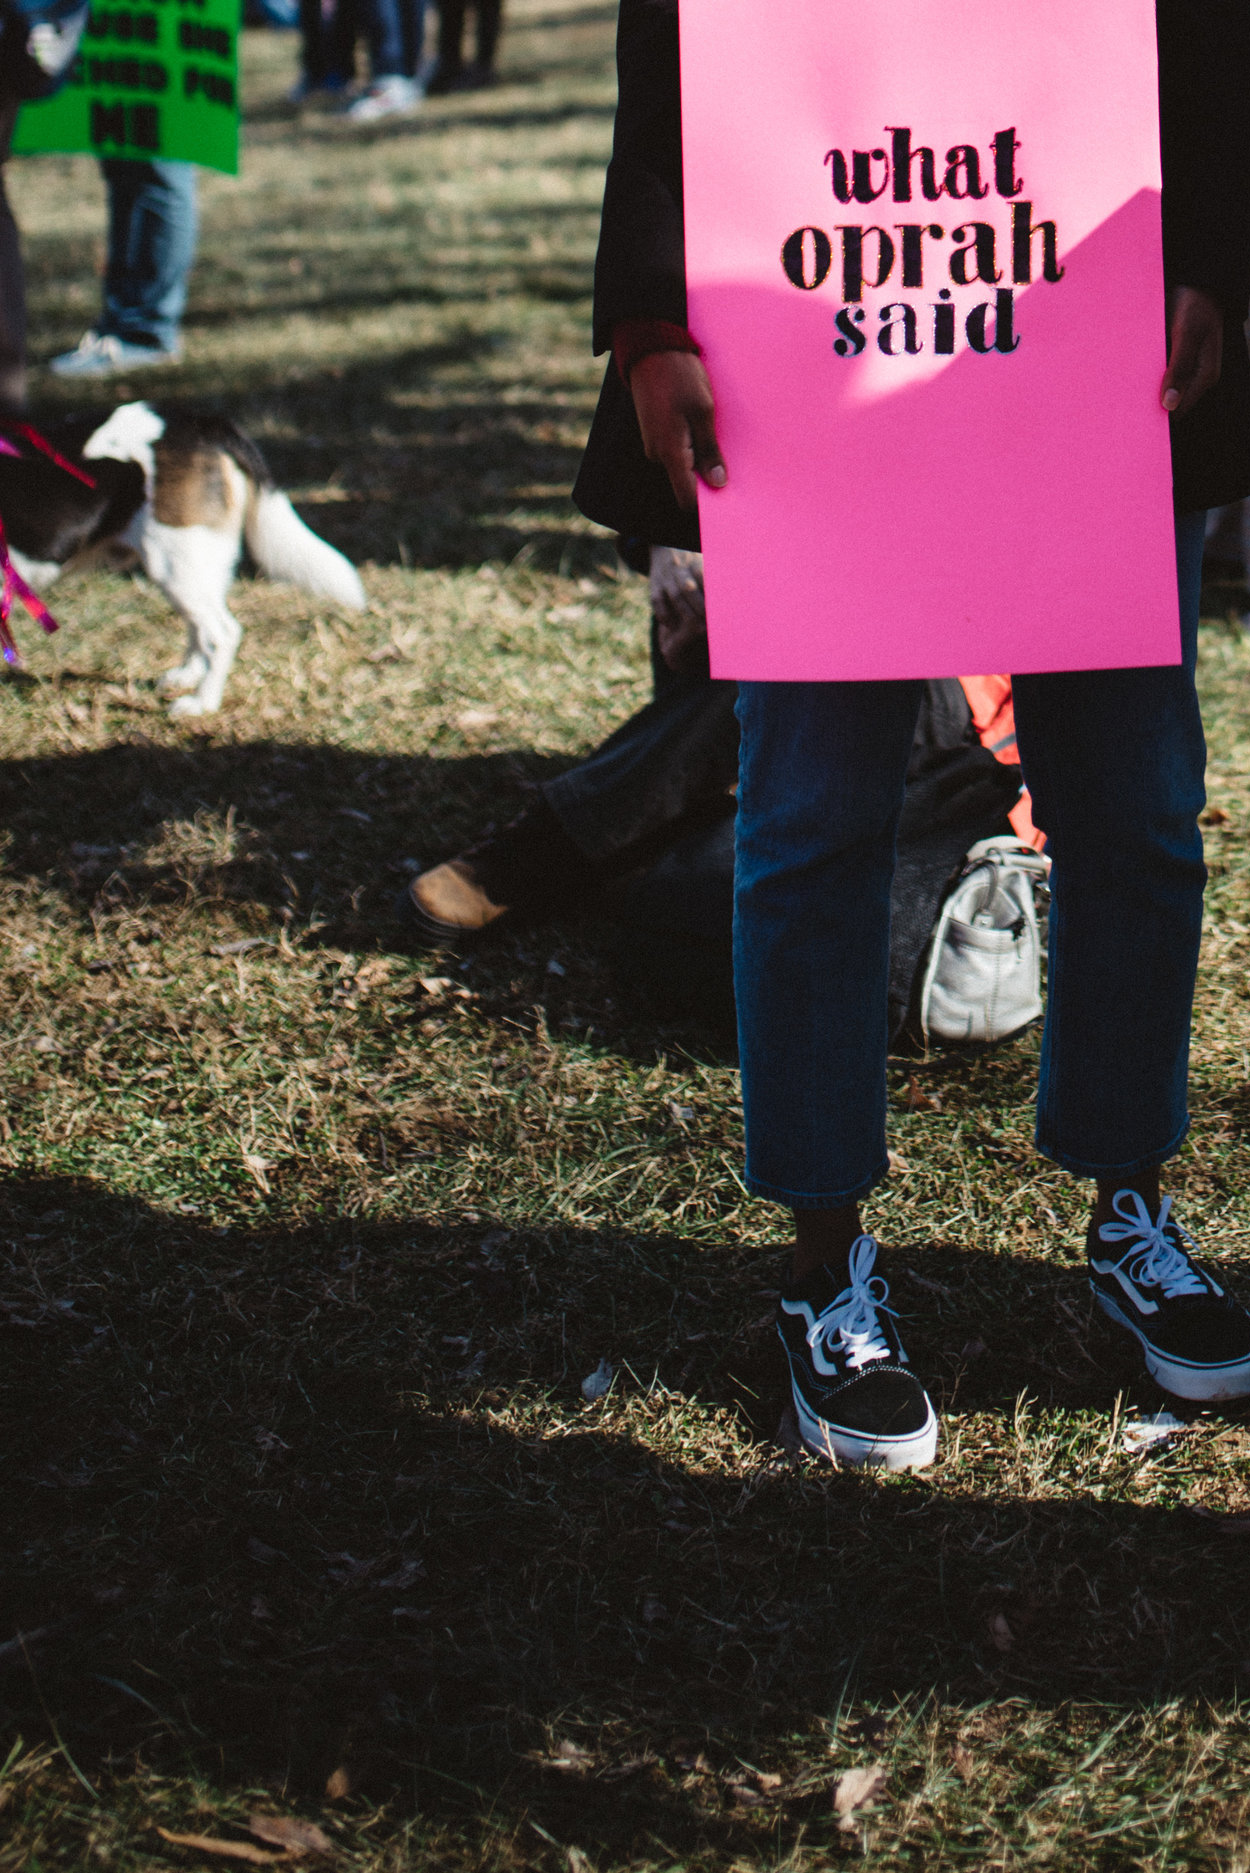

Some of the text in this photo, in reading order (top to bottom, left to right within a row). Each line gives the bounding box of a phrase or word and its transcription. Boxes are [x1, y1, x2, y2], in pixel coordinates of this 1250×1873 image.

[823, 126, 1024, 205] what
[780, 201, 1065, 304] oprah
[833, 287, 1021, 359] said
